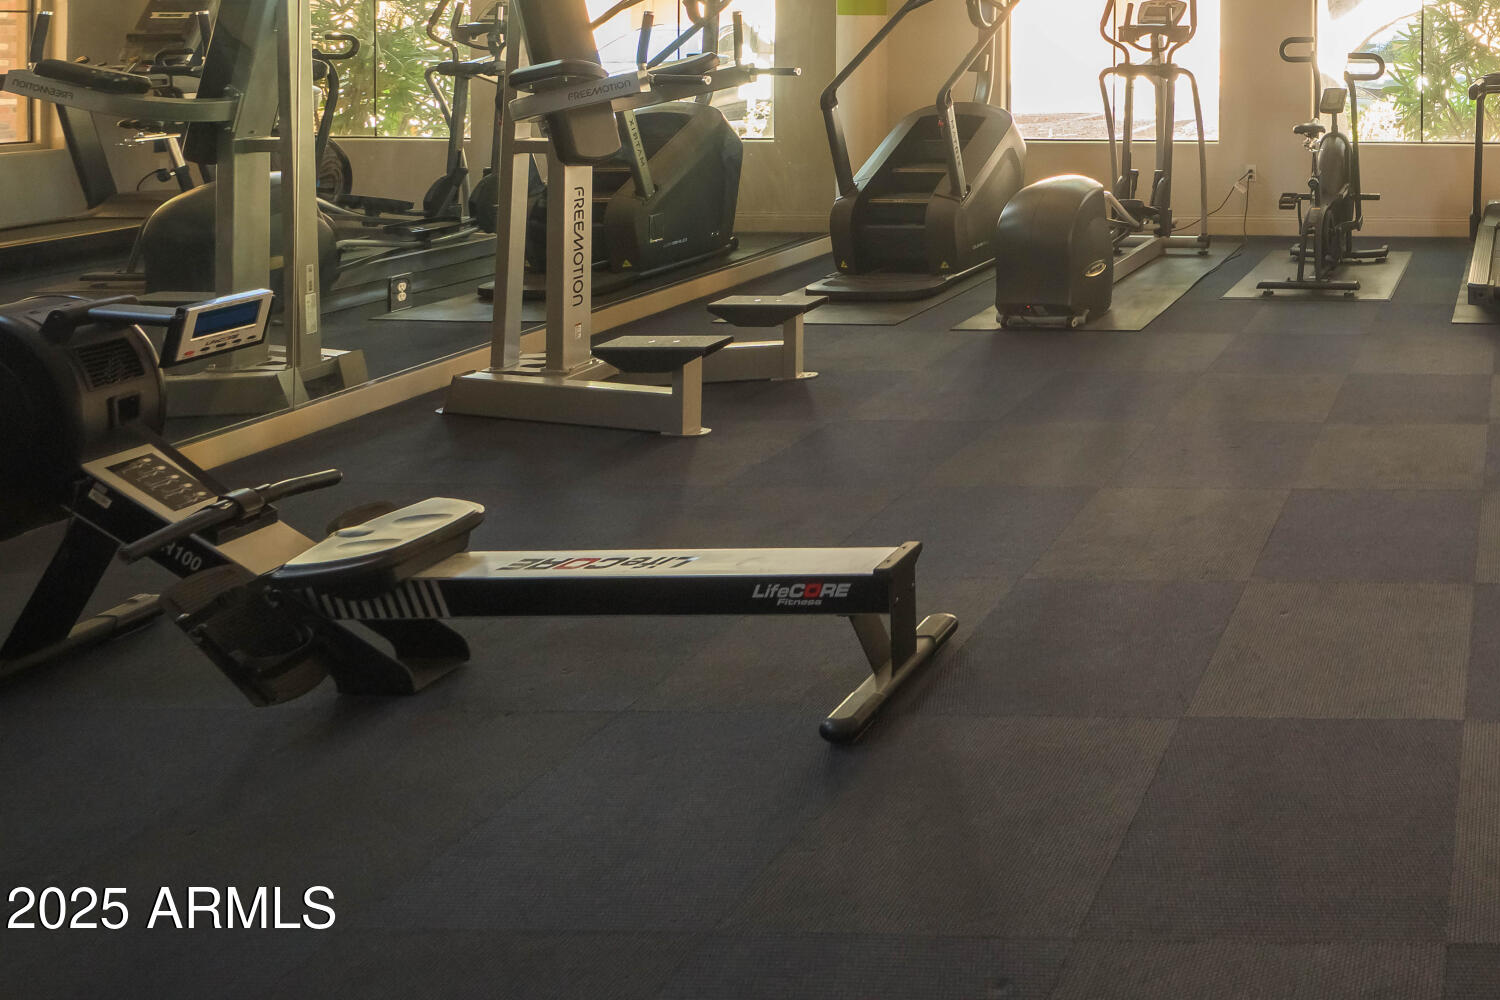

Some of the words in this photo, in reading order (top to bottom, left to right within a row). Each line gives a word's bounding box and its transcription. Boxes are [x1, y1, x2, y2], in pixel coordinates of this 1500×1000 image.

[567, 79, 632, 101] FREEMOTION
[572, 186, 585, 307] FREEMOTION
[751, 583, 852, 598] LifeCORE
[776, 598, 823, 606] Fitness
